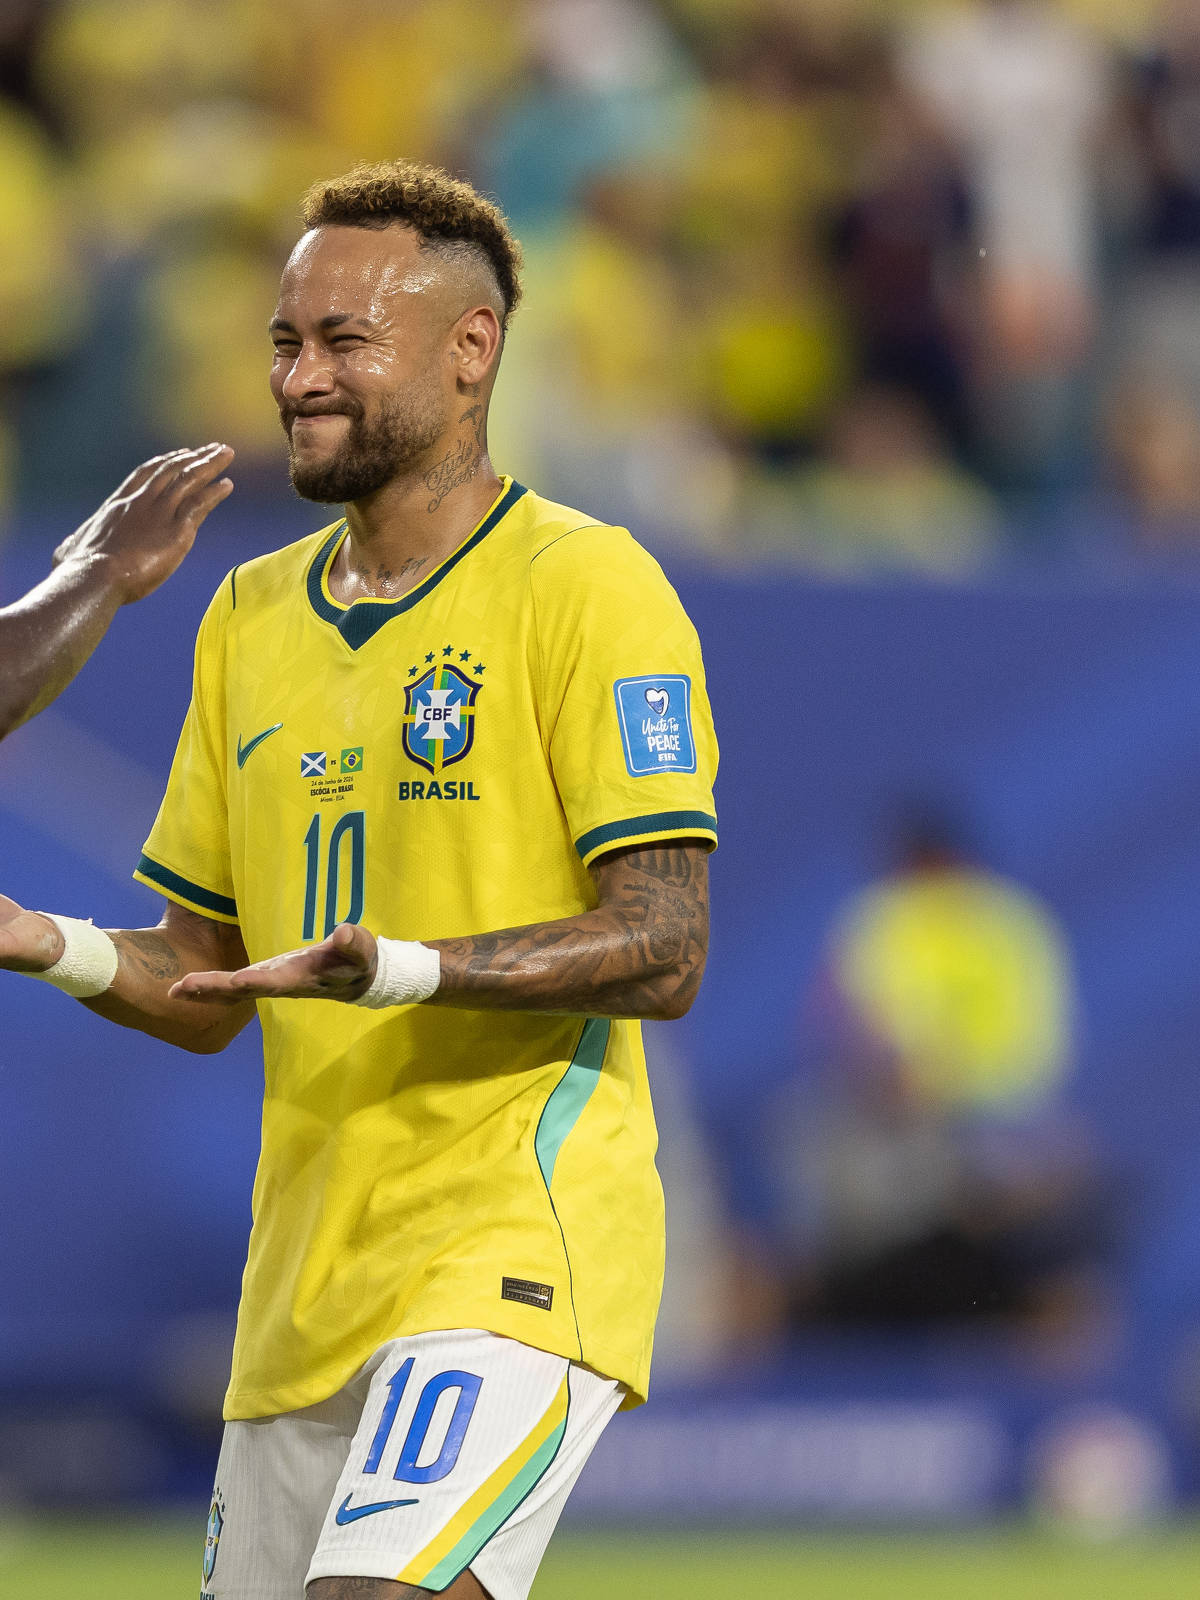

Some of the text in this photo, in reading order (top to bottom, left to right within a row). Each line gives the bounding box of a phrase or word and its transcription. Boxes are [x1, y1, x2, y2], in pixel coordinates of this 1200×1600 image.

[423, 707, 453, 721] CBF
[641, 717, 669, 736] Unite
[647, 734, 681, 753] PEACE
[657, 752, 678, 762] FIFA
[398, 780, 481, 801] BRASIL
[302, 809, 366, 942] 10
[362, 1356, 484, 1485] 10
